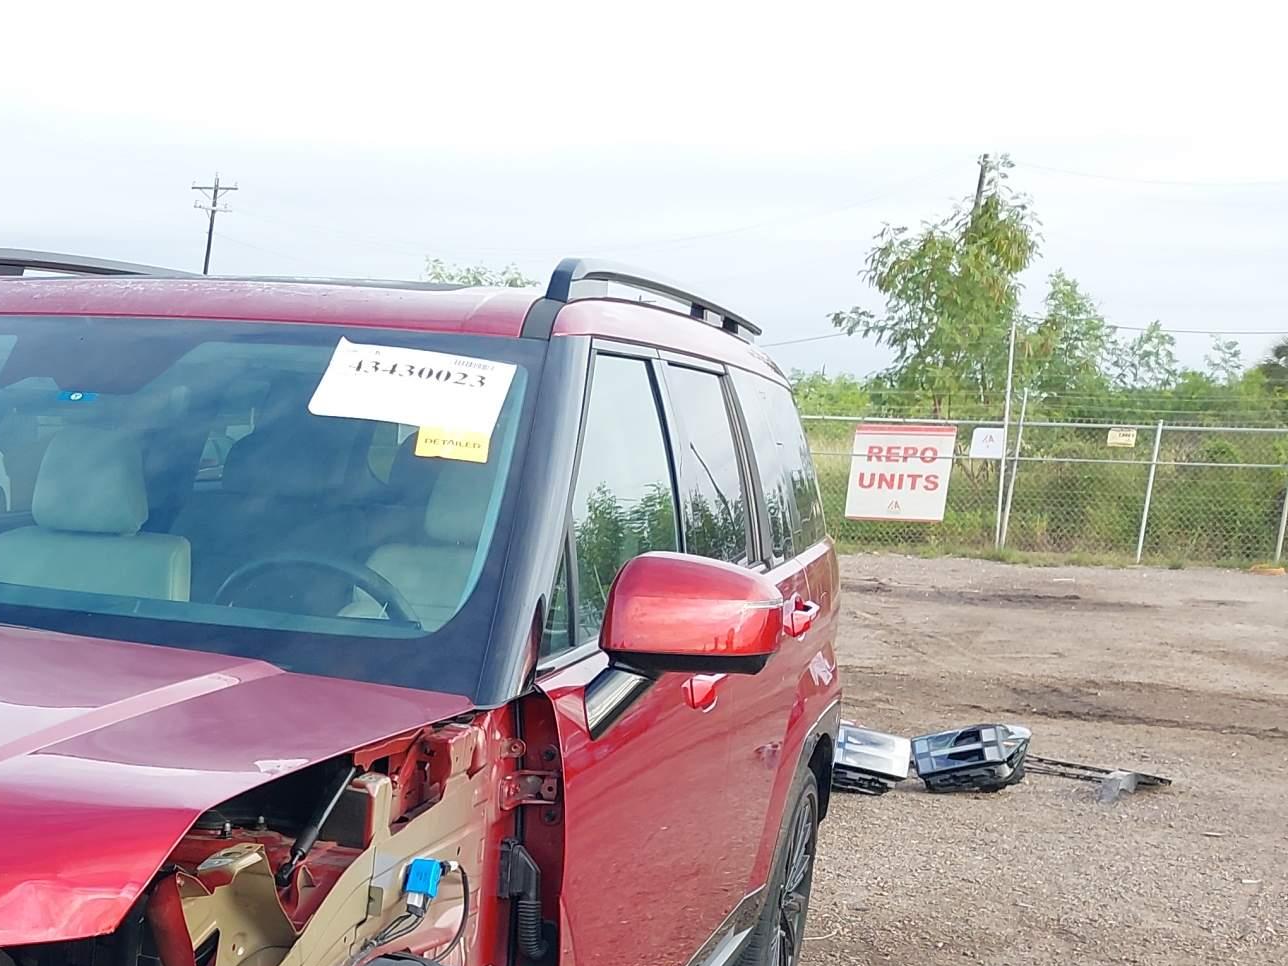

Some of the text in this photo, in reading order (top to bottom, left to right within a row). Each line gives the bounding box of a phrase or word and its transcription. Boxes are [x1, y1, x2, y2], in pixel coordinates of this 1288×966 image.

[348, 359, 487, 388] 43430023
[423, 437, 482, 450] DETAILED
[866, 445, 939, 464] REPO
[858, 472, 940, 491] UNITS
